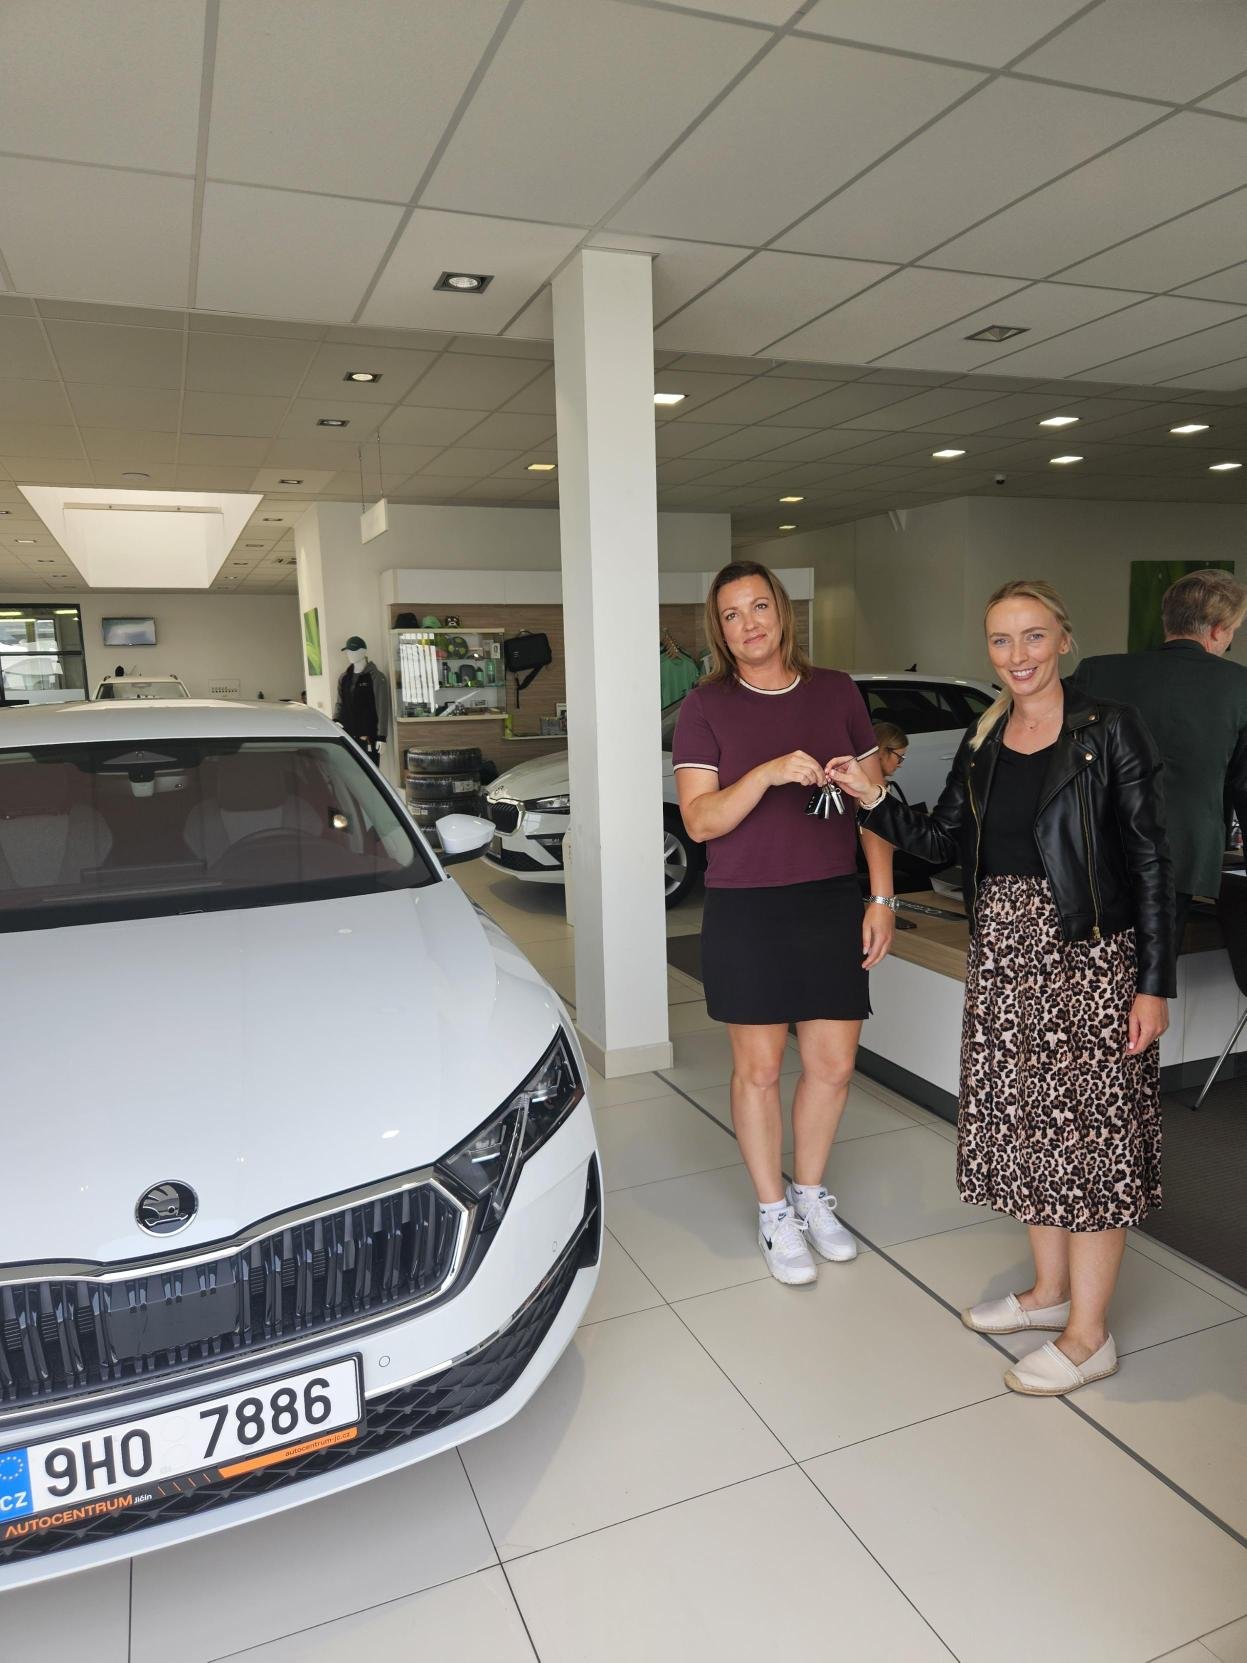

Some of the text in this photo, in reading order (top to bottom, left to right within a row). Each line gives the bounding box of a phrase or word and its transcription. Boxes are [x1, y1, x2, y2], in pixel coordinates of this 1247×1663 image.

[200, 1377, 332, 1460] 7886
[0, 1490, 28, 1511] CZ
[4, 1494, 134, 1540] AUTOCENTRUM
